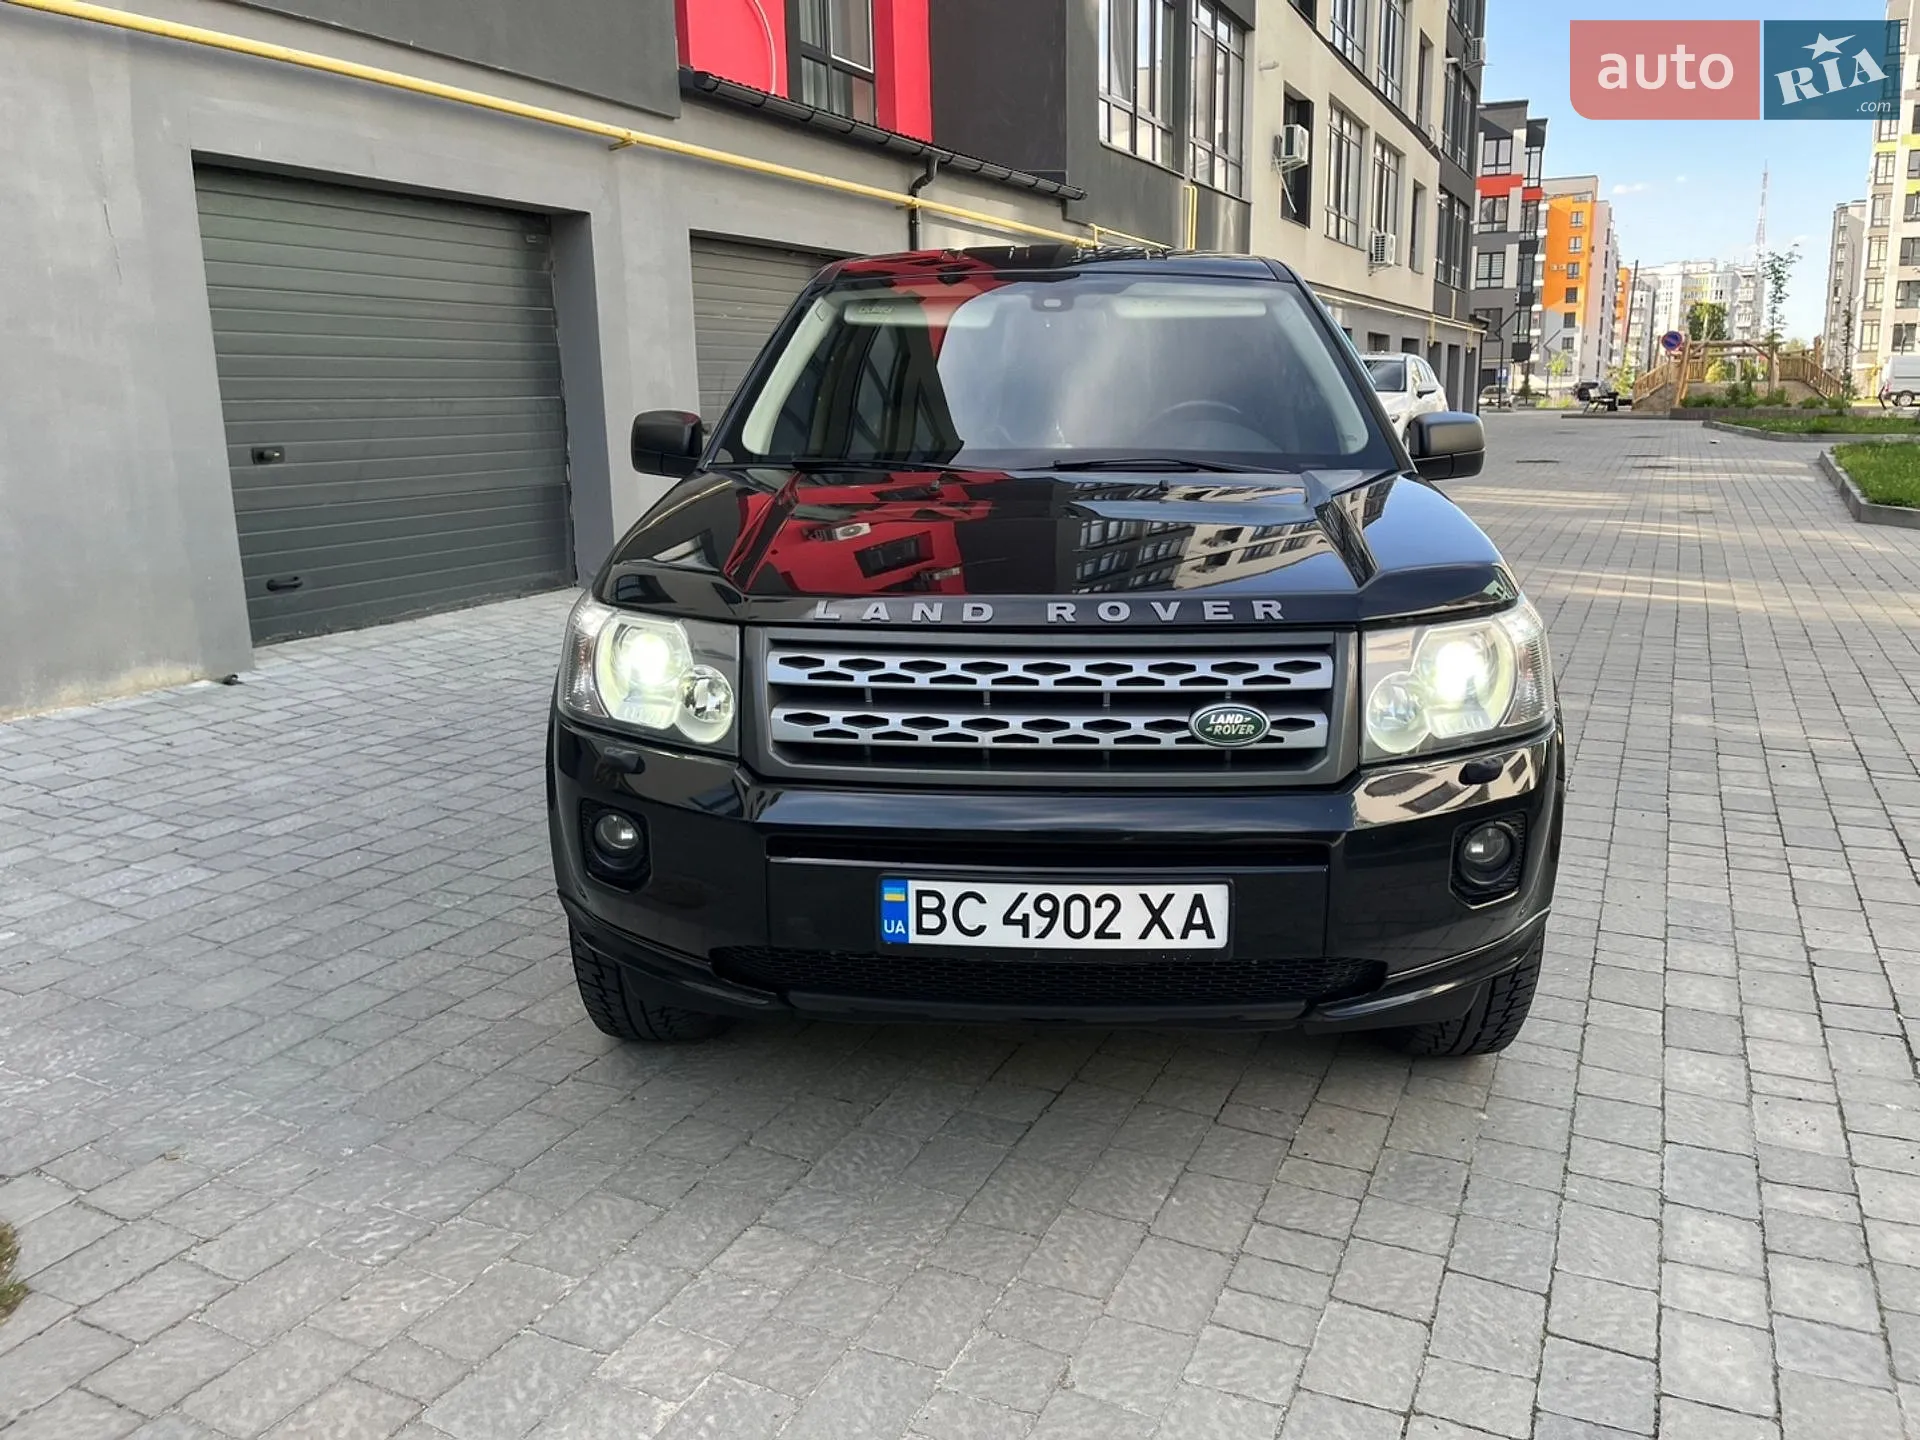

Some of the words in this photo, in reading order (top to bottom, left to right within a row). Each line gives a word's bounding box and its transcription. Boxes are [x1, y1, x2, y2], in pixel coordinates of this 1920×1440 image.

[814, 601, 994, 623] LAND
[1046, 600, 1285, 622] ROVER
[1209, 713, 1244, 725] LAND
[1213, 724, 1255, 735] ROVER
[915, 889, 987, 937] BC
[1002, 892, 1121, 940] 4902
[1138, 893, 1216, 940] XA
[884, 919, 906, 934] UA
